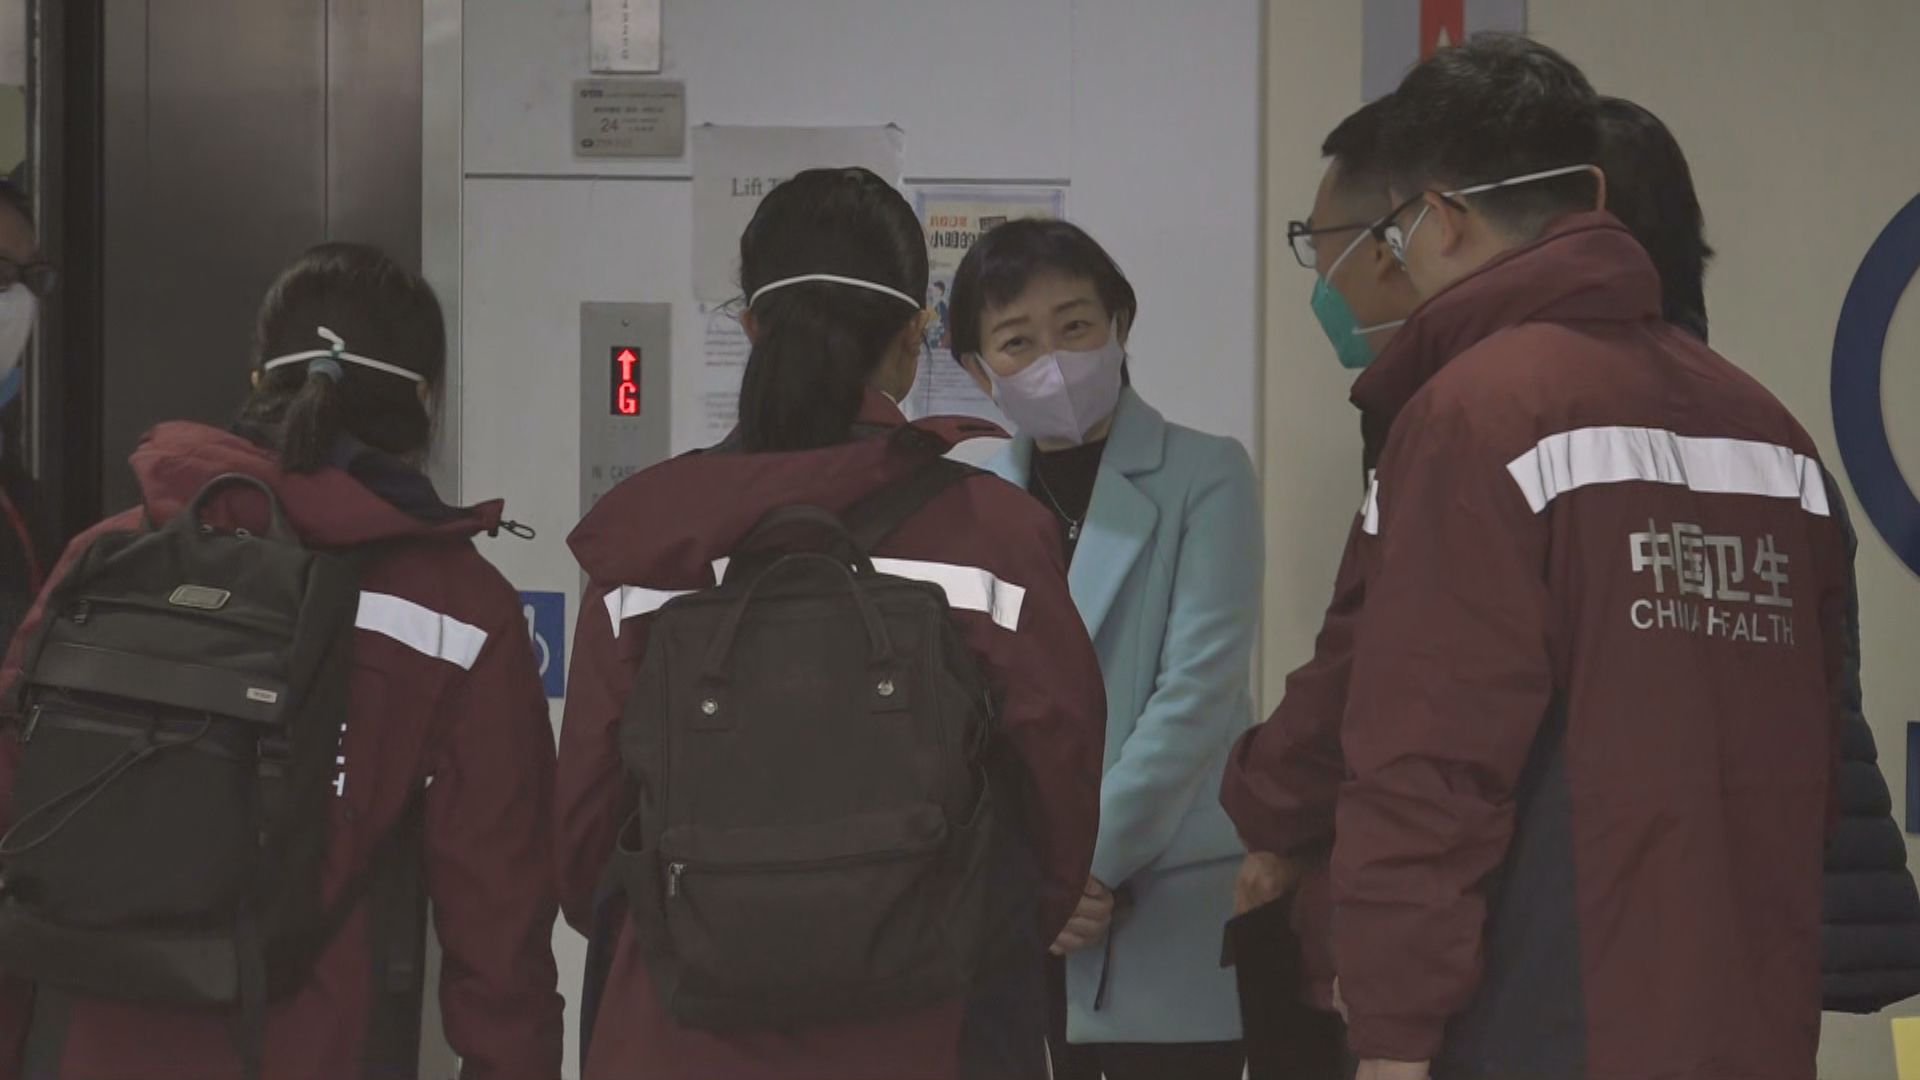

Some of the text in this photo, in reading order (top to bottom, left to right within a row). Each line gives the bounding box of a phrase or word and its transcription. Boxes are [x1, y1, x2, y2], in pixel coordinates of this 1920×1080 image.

[601, 117, 620, 133] 24
[731, 177, 763, 197] Lift
[618, 381, 637, 414] G
[1629, 517, 1793, 607] 中国卫生
